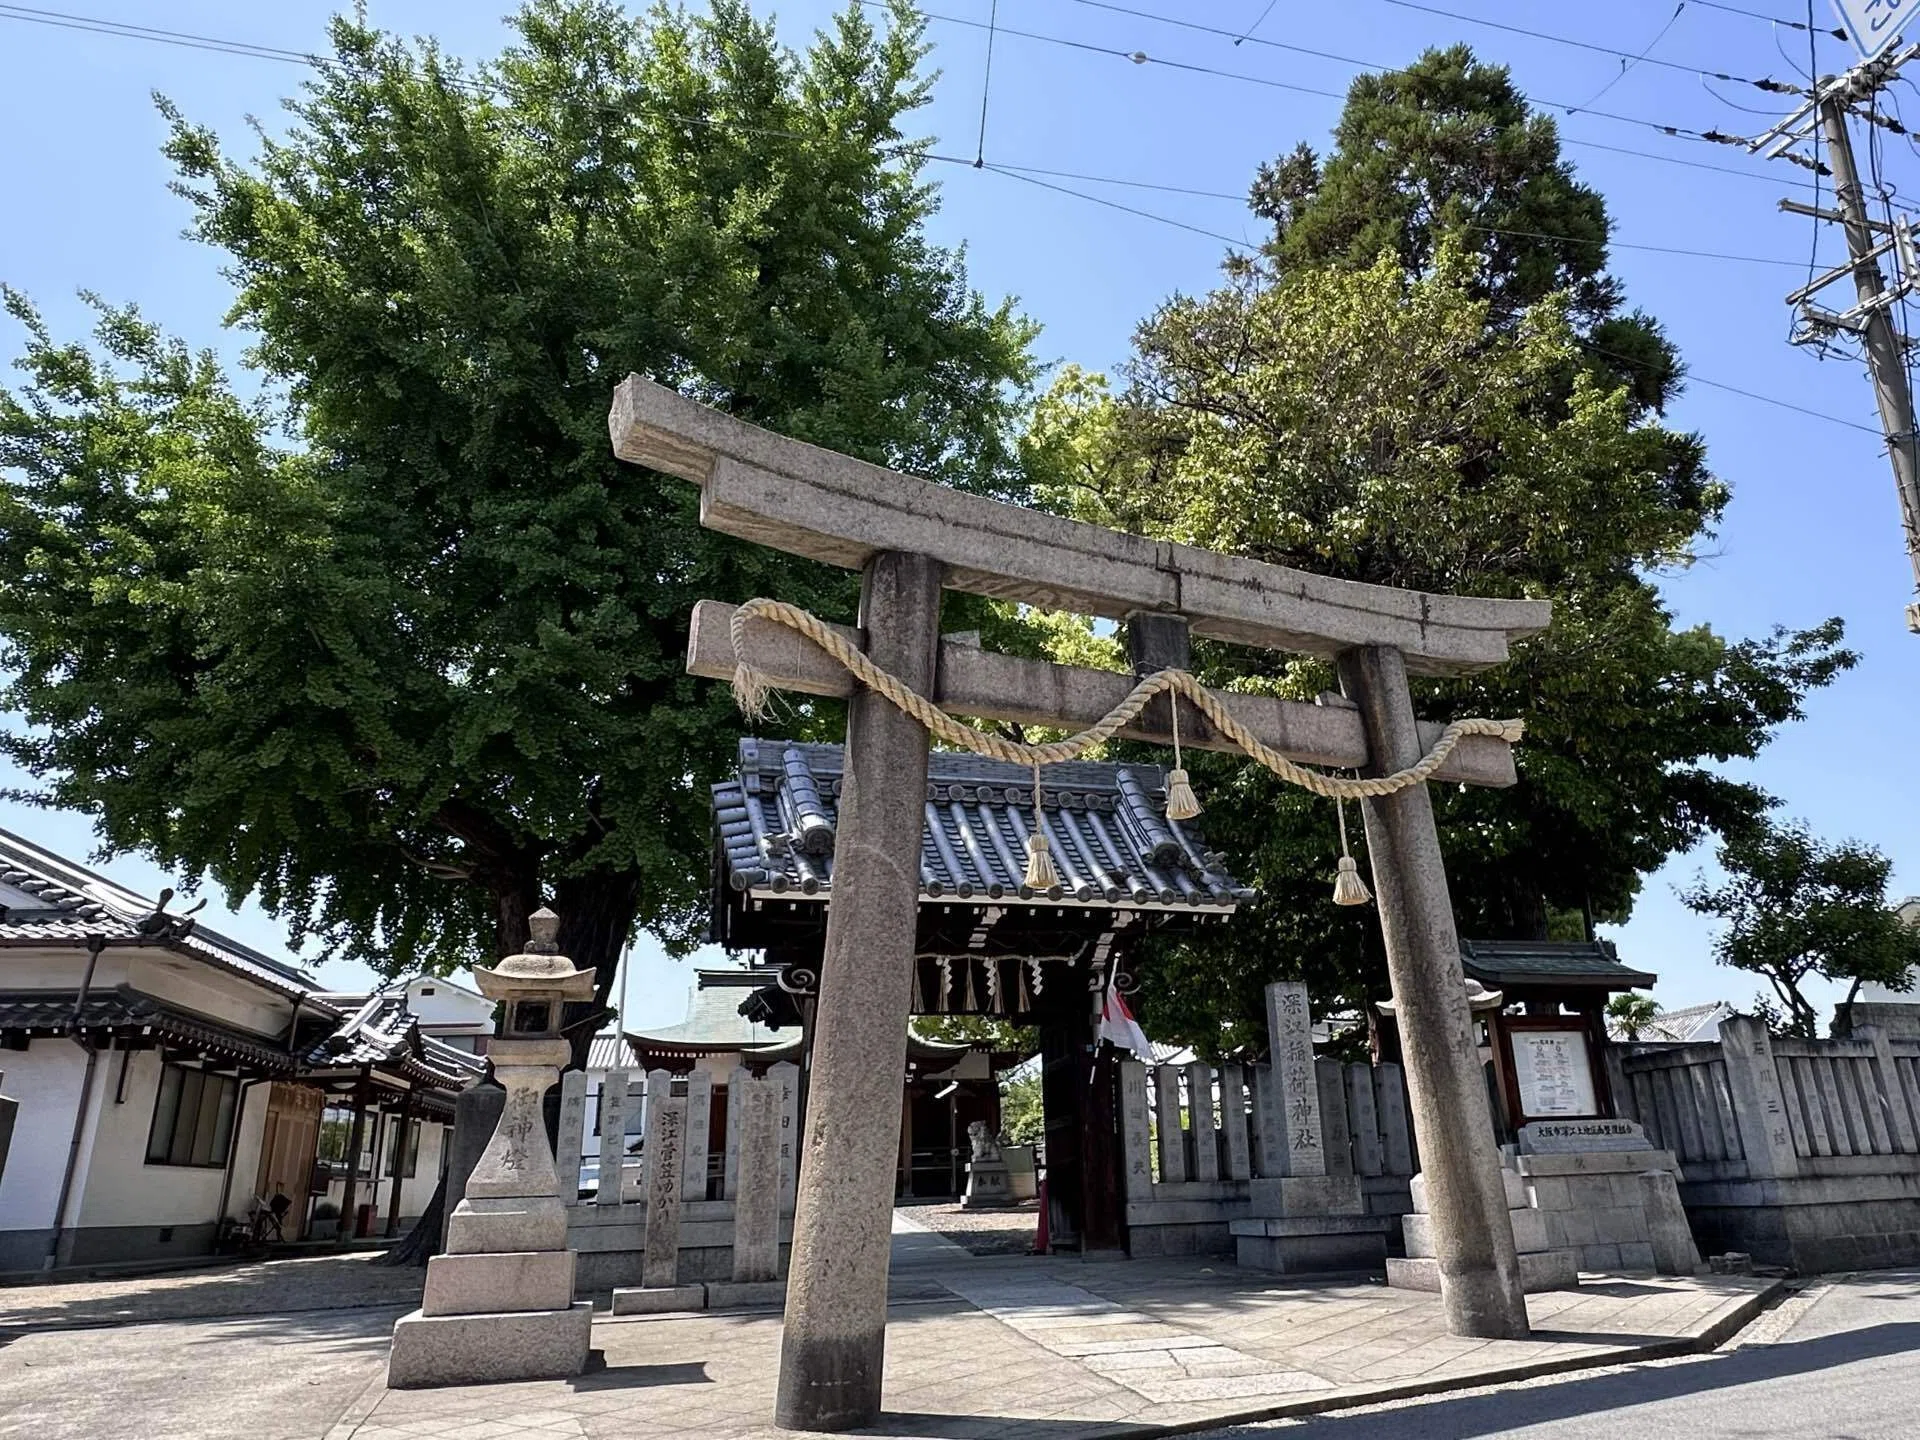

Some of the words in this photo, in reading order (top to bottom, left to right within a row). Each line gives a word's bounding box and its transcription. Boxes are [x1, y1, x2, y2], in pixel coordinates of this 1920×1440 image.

[1281, 994, 1317, 1150] 深江稲荷神社
